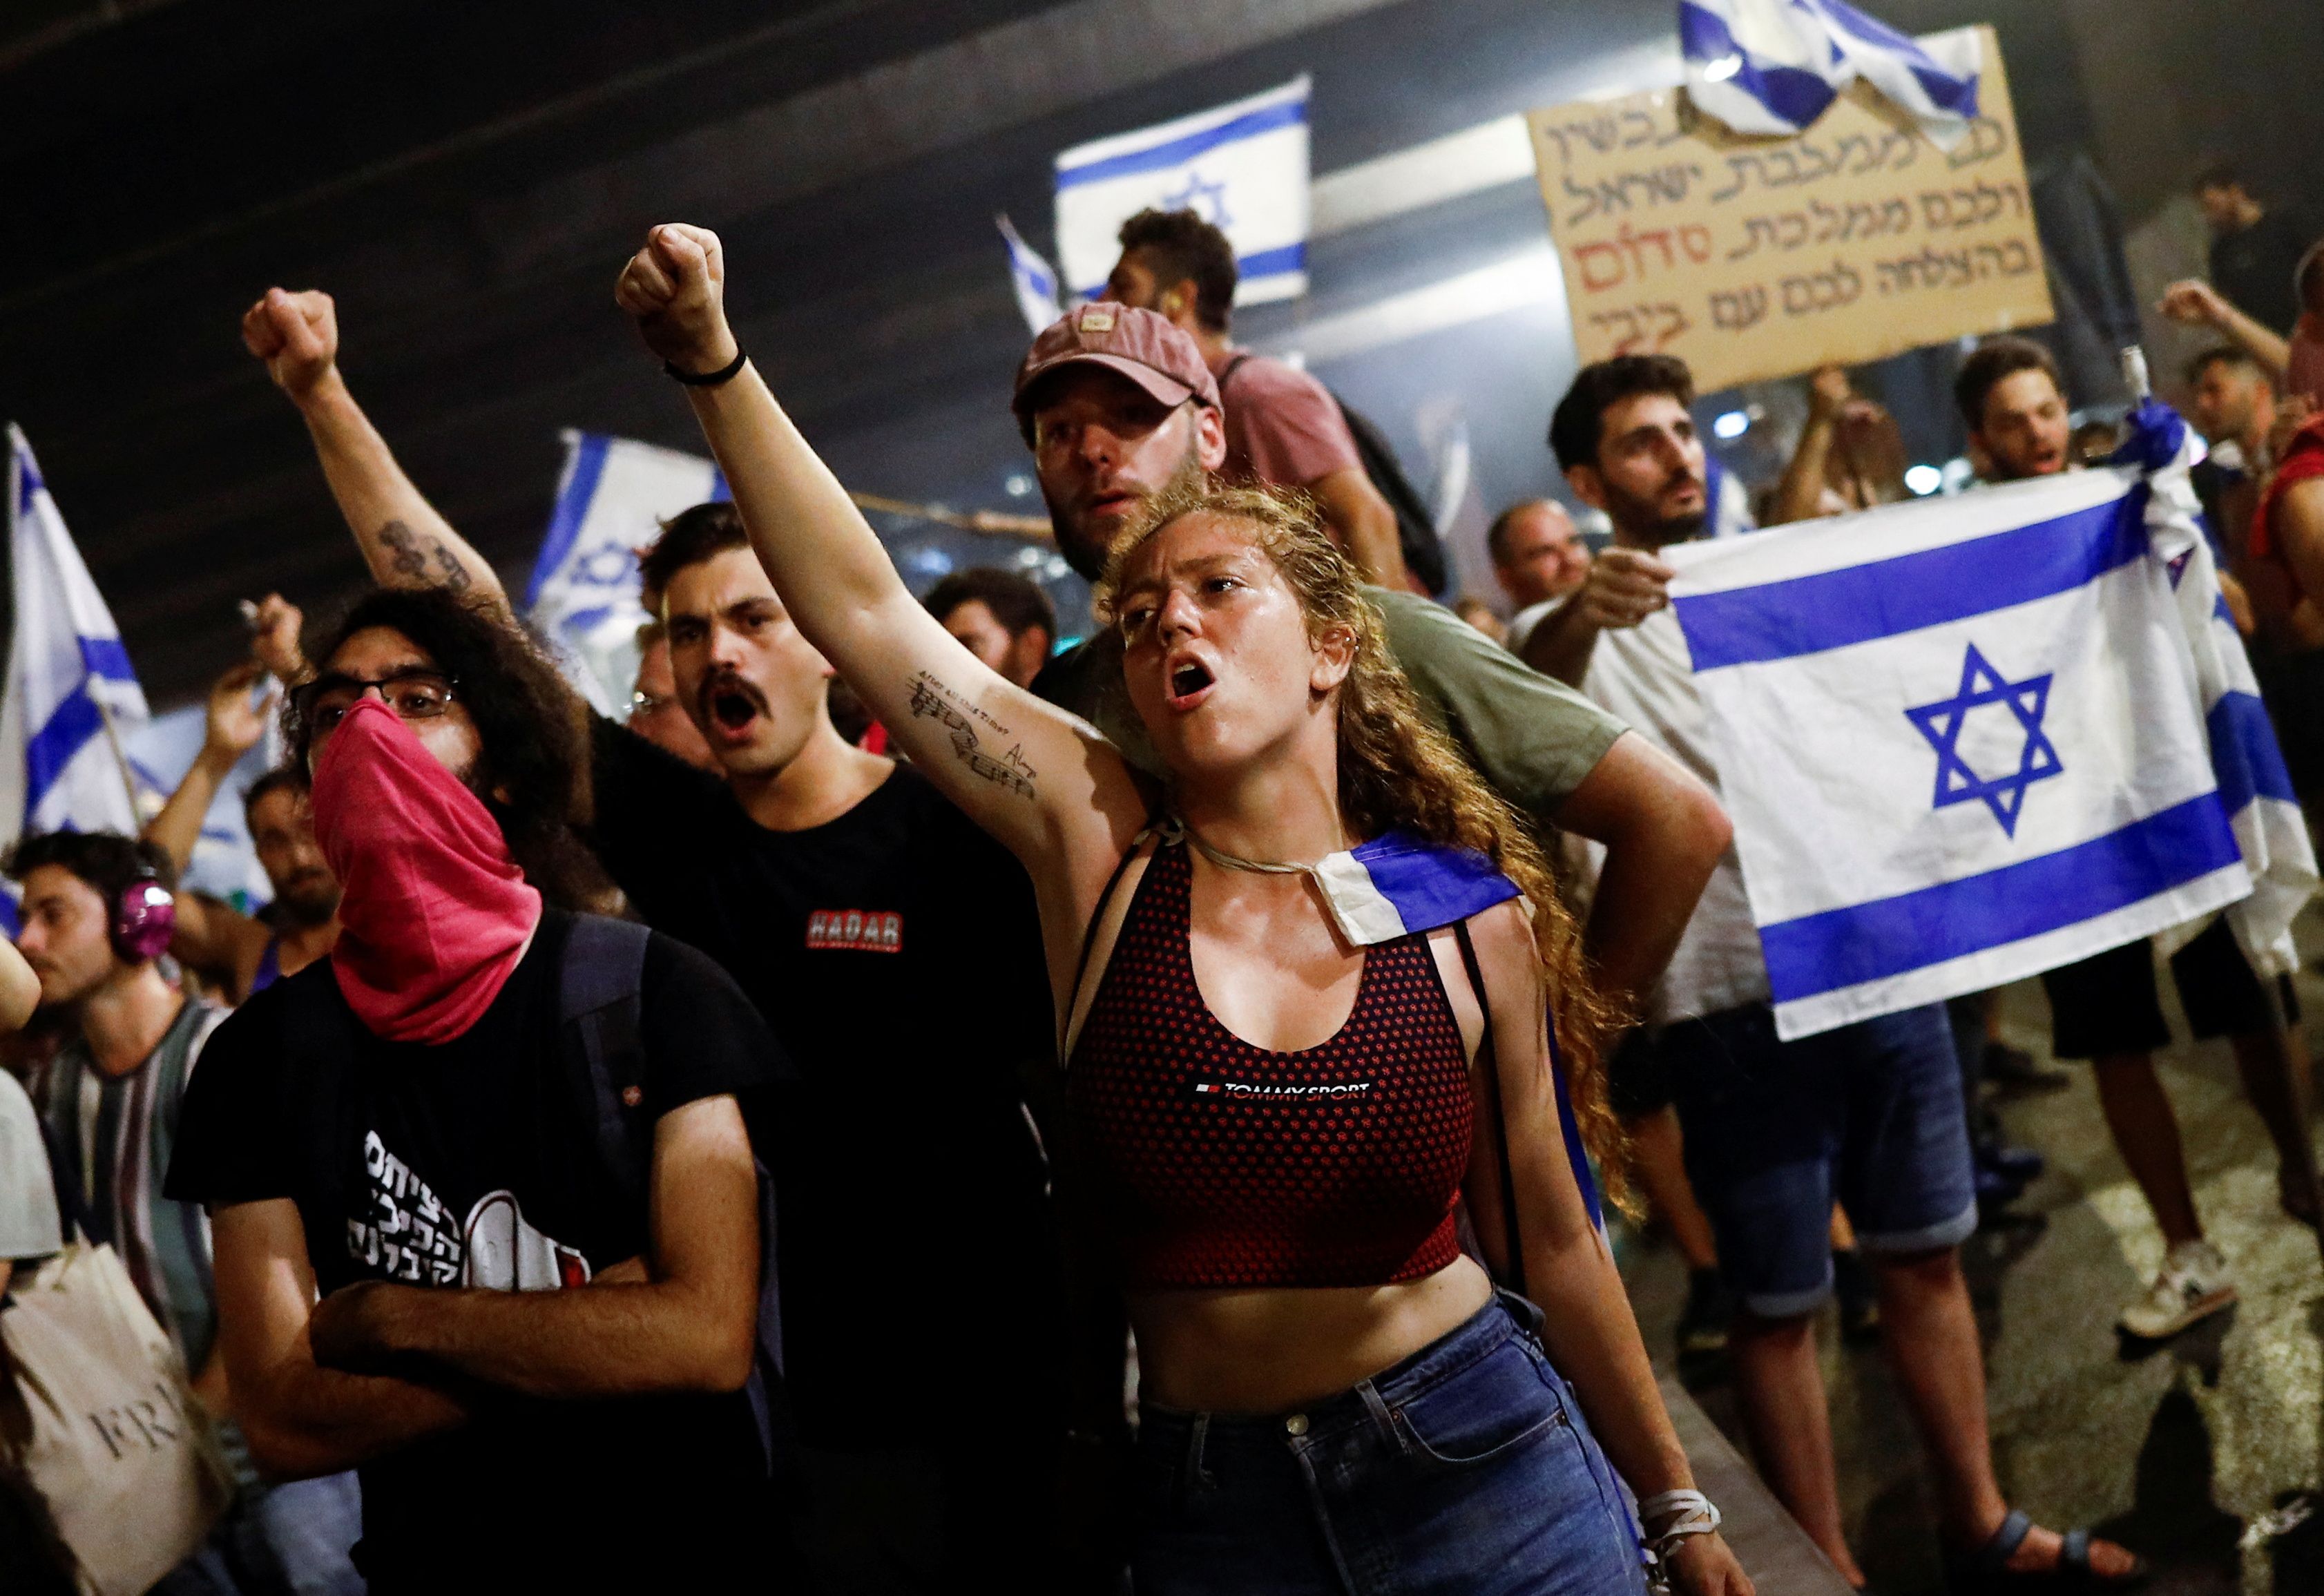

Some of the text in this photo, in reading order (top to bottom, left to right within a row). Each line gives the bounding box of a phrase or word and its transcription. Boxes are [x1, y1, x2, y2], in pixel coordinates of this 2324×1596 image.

[1562, 162, 1703, 228] ישראל
[1726, 198, 1912, 262] ממלכת
[1780, 256, 1863, 316] לכם
[1874, 236, 2033, 296] בהצלחה
[1709, 283, 1769, 331] עם
[807, 913, 900, 945] HADAR
[1225, 1083, 1370, 1101] TOMMY SPORT
[367, 1187, 462, 1262] הפיכ
